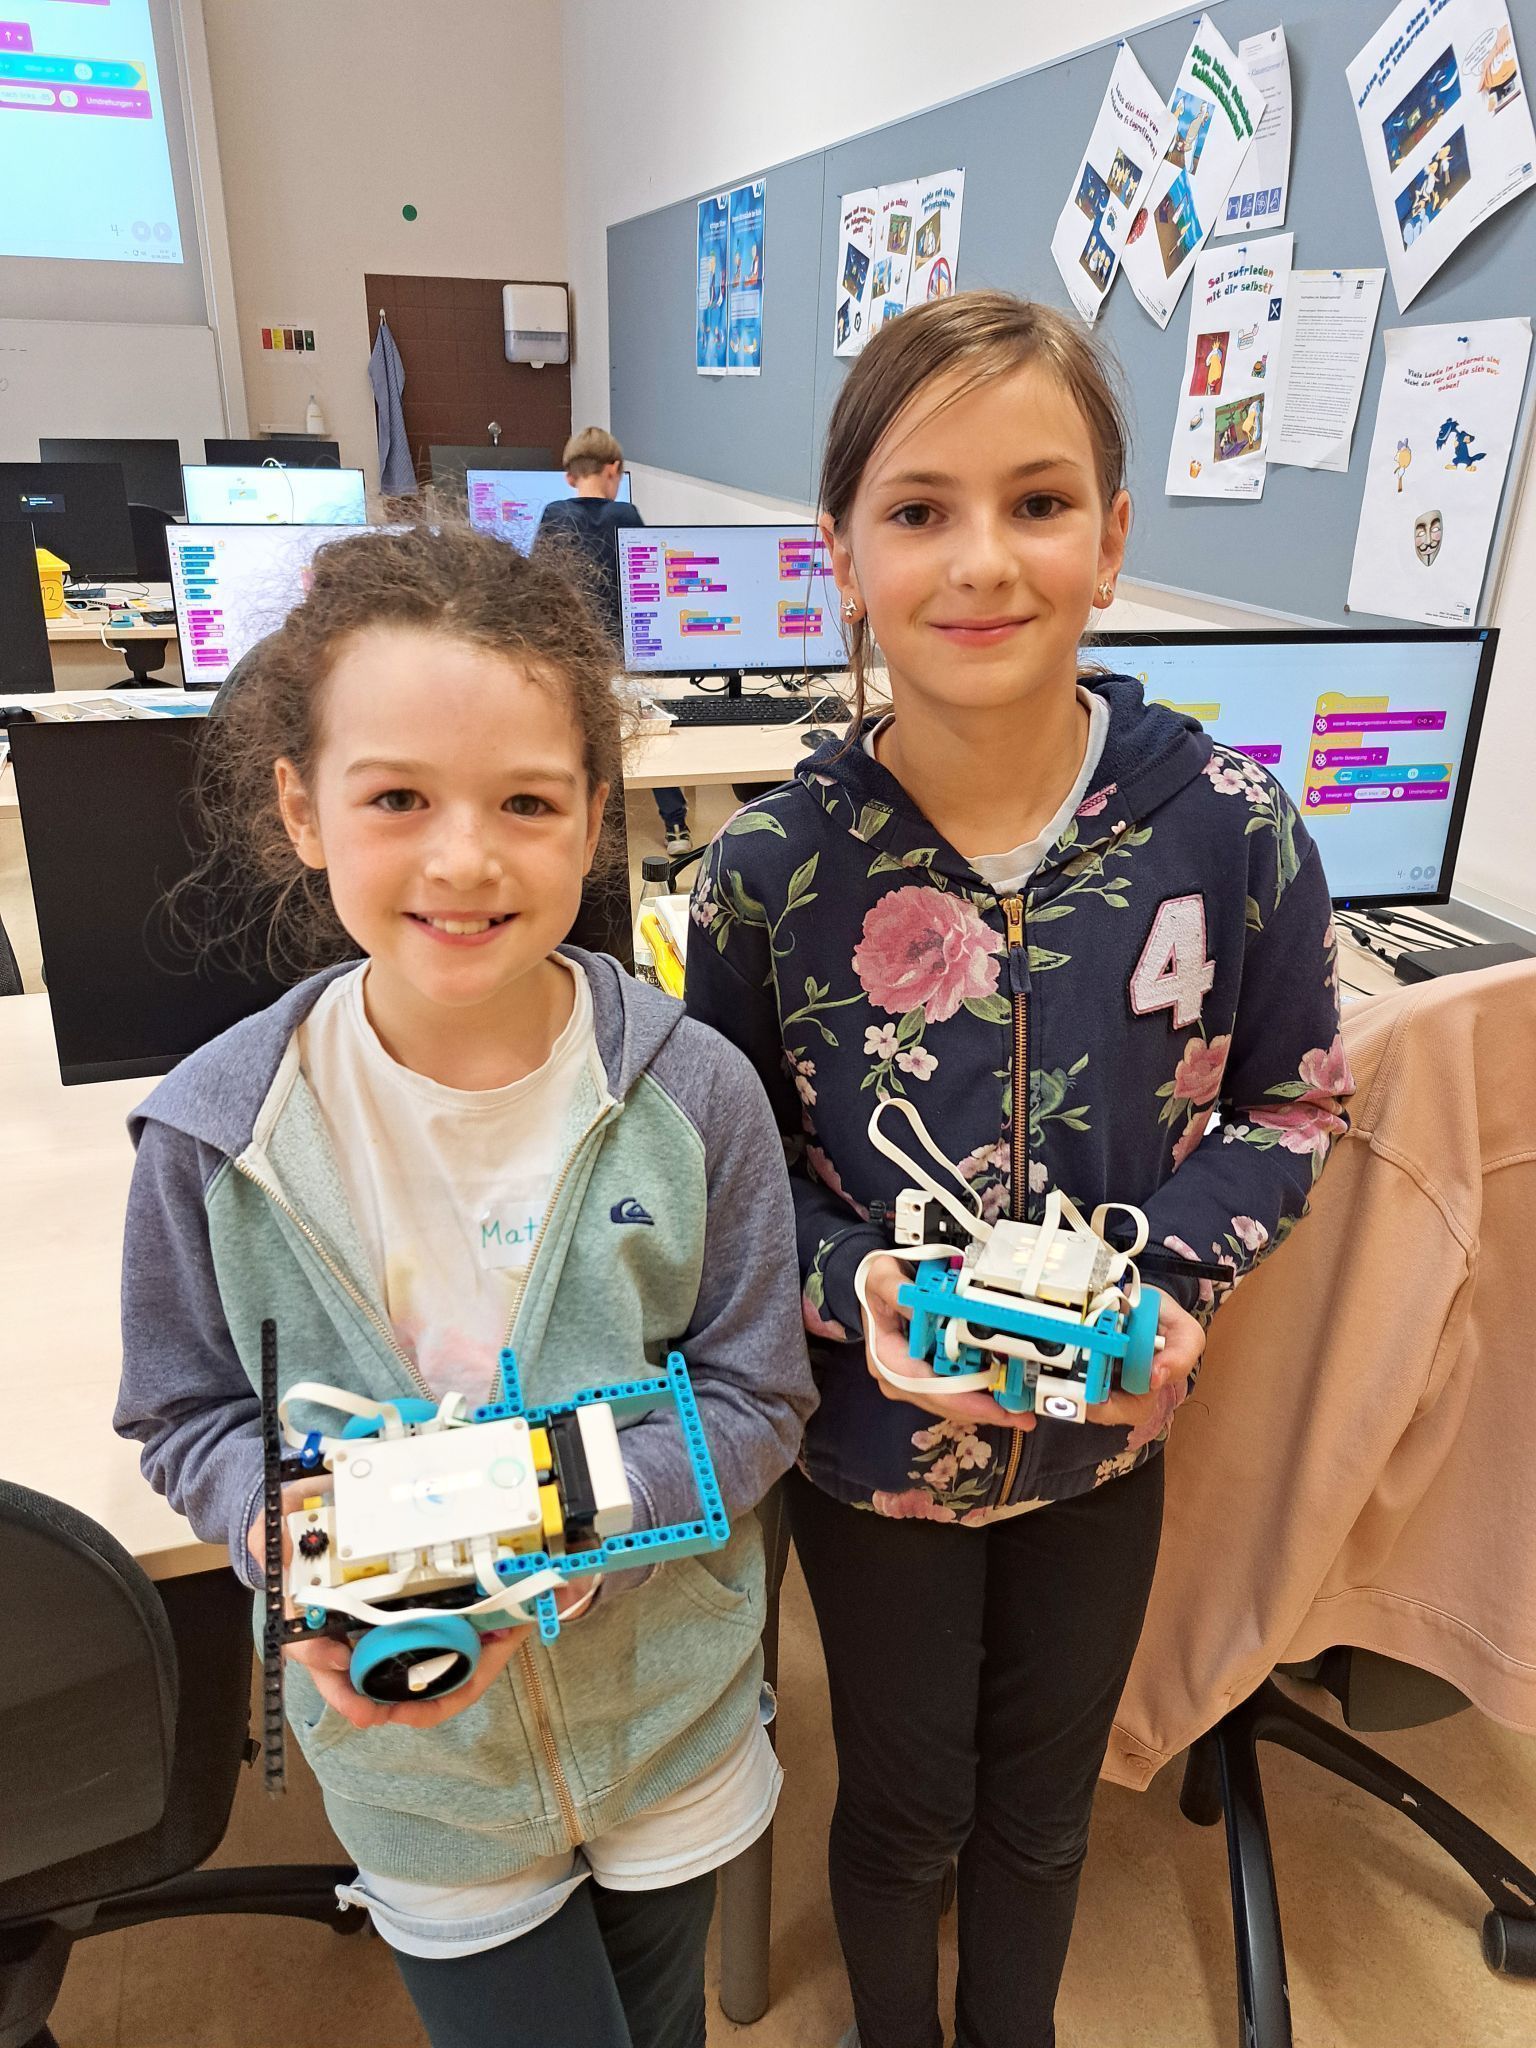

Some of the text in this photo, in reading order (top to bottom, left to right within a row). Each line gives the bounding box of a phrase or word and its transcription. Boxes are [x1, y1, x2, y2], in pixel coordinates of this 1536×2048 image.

[1208, 264, 1274, 288] Sei zufrieden
[1206, 280, 1274, 305] mit dir selbst!
[1408, 368, 1423, 378] Viele
[1424, 369, 1443, 379] Leute
[1456, 356, 1485, 368] Internet
[1433, 377, 1444, 385] für
[1446, 373, 1457, 381] die
[1471, 365, 1485, 373] sich
[1437, 380, 1460, 392] geben!
[1130, 894, 1216, 1030] 4
[482, 1216, 544, 1248] Mat
